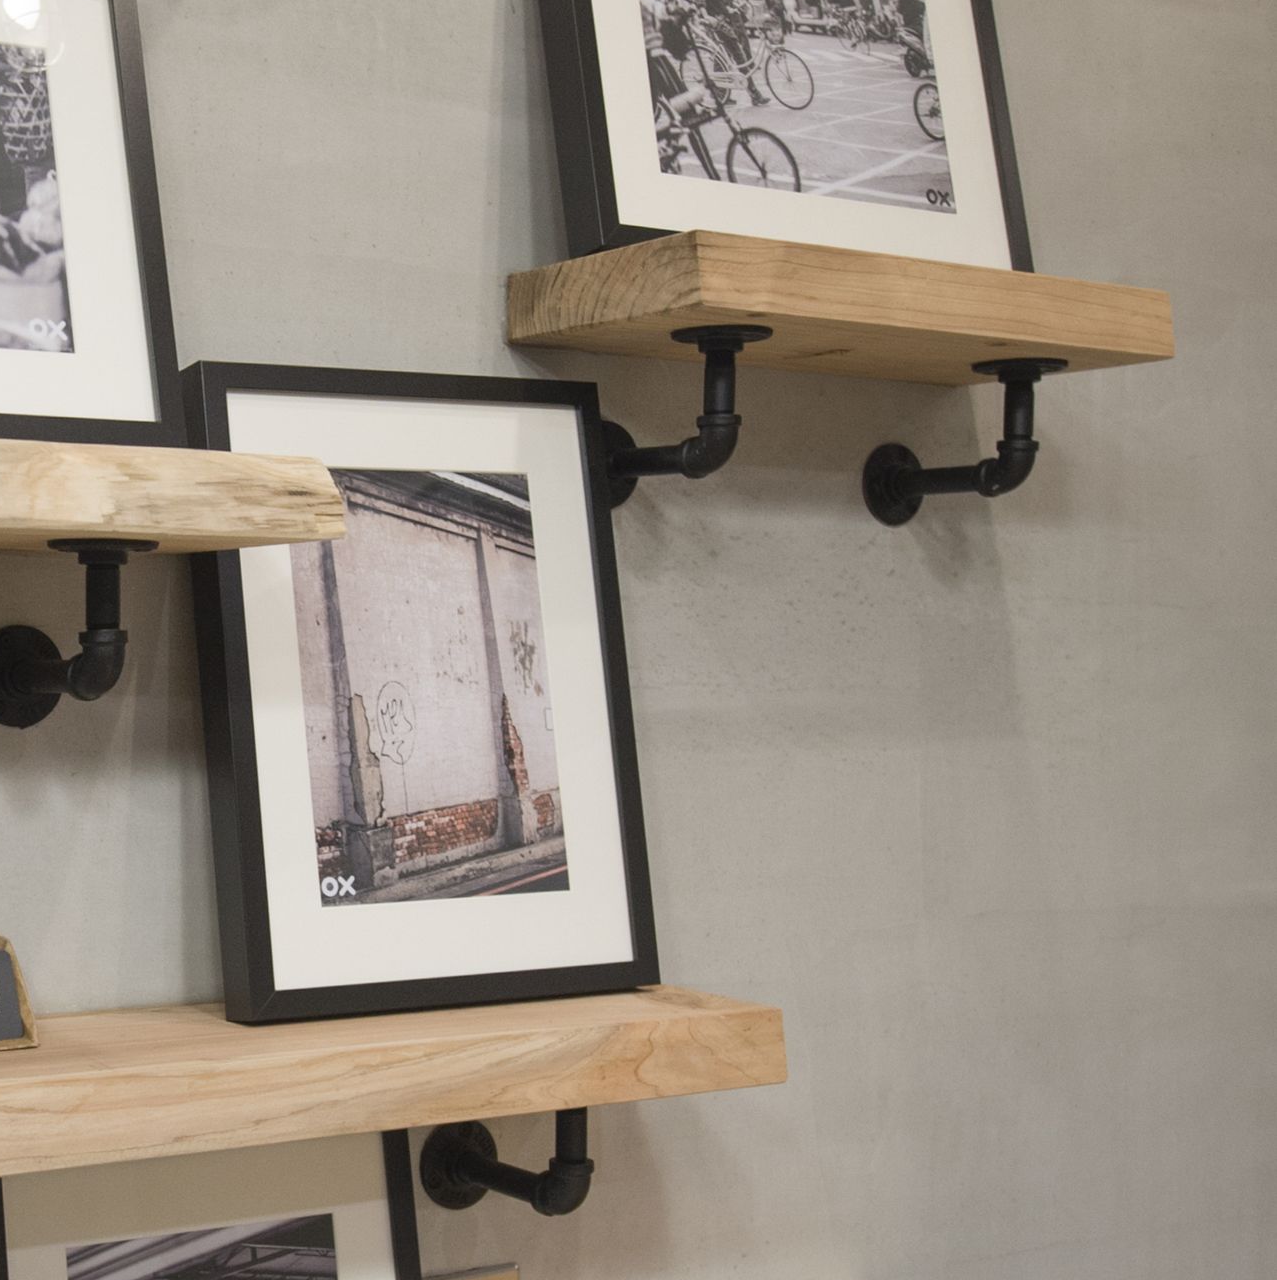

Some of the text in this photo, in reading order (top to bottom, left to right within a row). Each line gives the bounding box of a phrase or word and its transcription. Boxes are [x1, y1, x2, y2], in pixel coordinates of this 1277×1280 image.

[925, 189, 951, 207] OX
[28, 318, 68, 341] OX
[321, 875, 356, 897] OX
